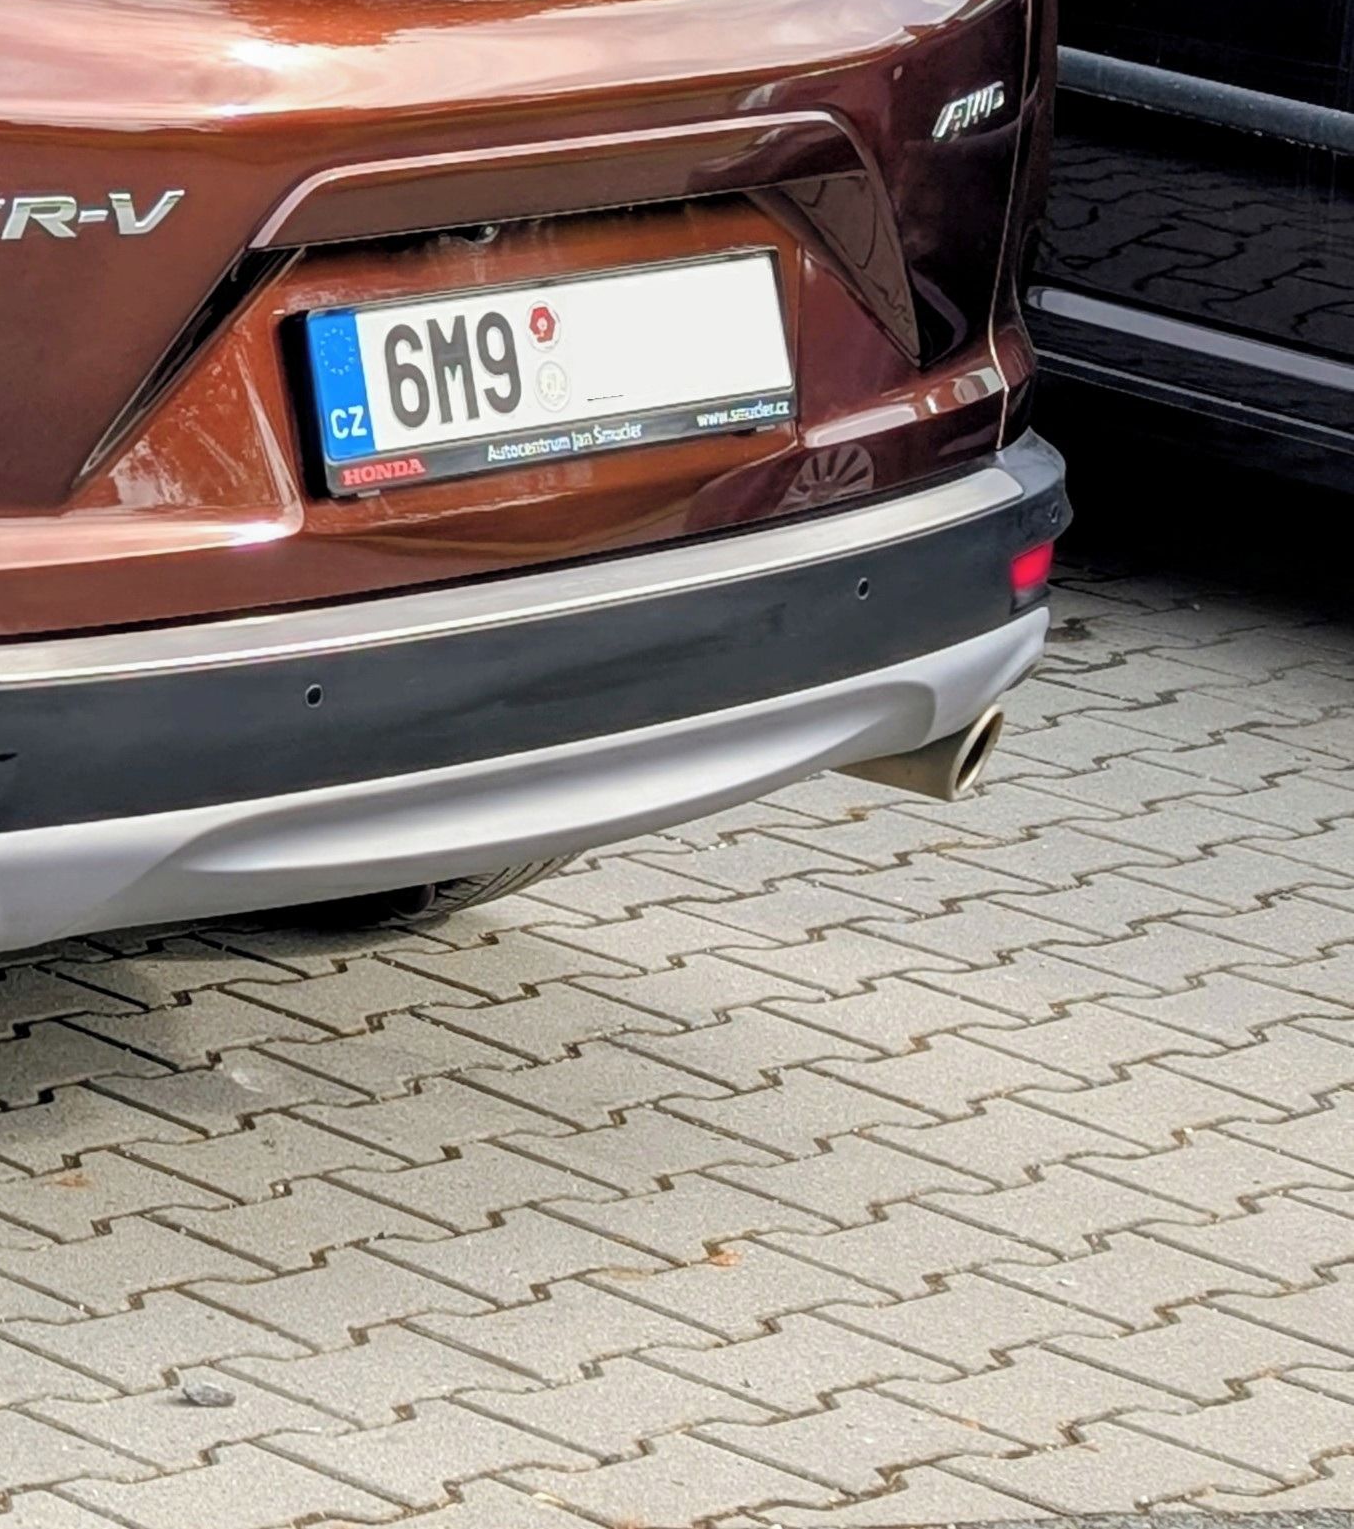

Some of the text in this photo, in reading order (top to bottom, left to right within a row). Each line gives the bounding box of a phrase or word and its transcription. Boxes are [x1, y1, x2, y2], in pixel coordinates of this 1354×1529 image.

[384, 311, 522, 430] 6M9
[330, 405, 368, 439] CZ
[487, 436, 571, 462] Autocentrum
[571, 431, 593, 451] Jan
[342, 458, 426, 486] HONDA
